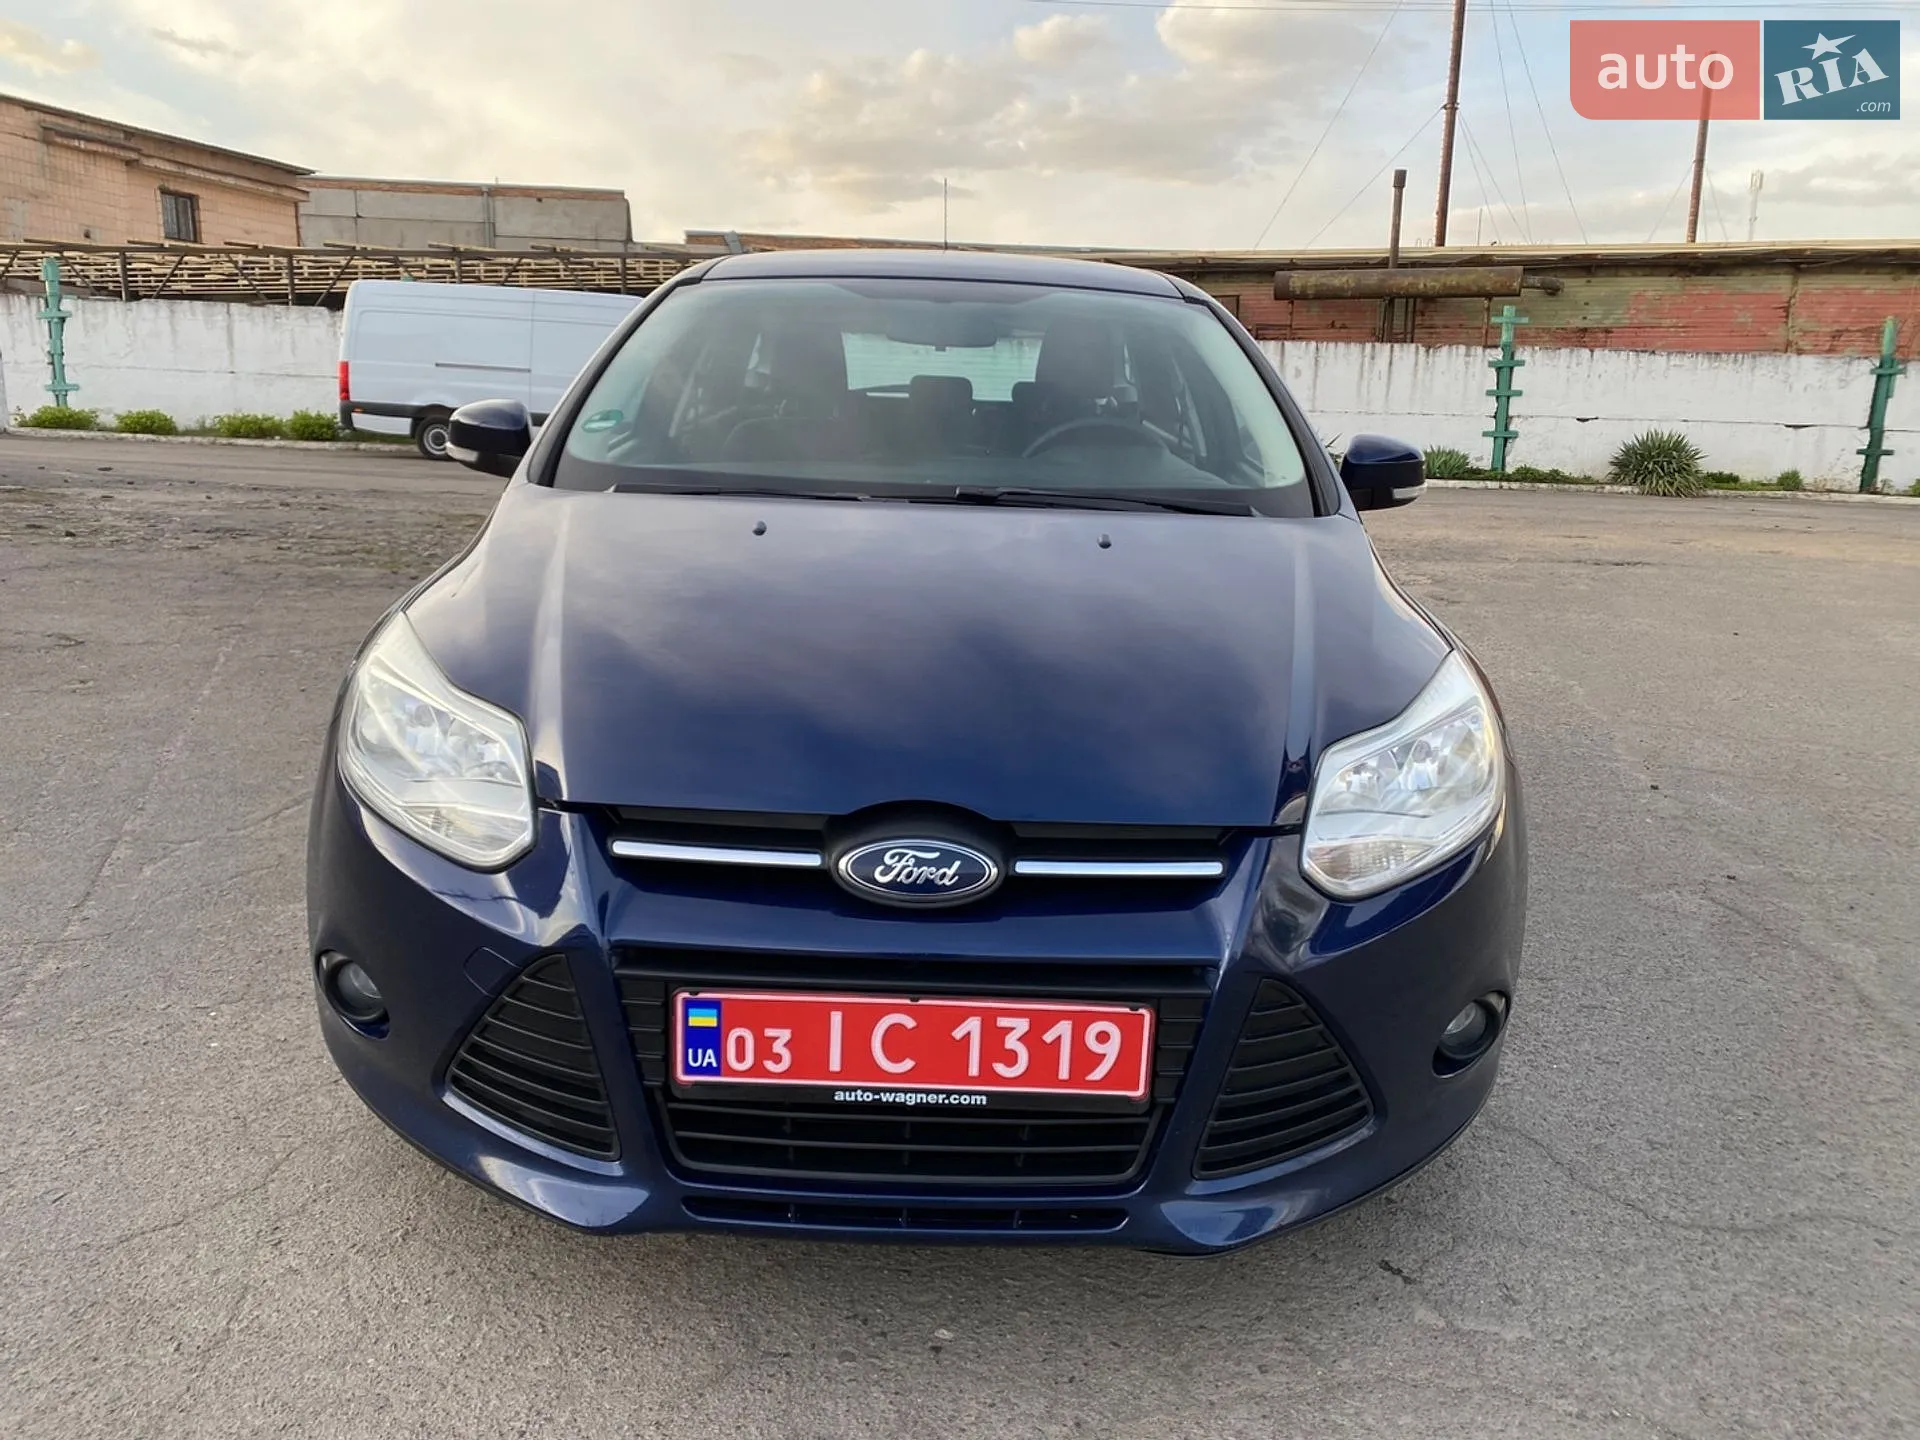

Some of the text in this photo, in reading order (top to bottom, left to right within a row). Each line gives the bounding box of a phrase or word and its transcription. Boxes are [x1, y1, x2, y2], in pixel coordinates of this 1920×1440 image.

[873, 849, 962, 886] Ford
[687, 1048, 718, 1068] UA
[726, 1027, 793, 1074] 03
[951, 1016, 1122, 1081] 1319
[833, 1087, 988, 1107] auto-wagner.com
